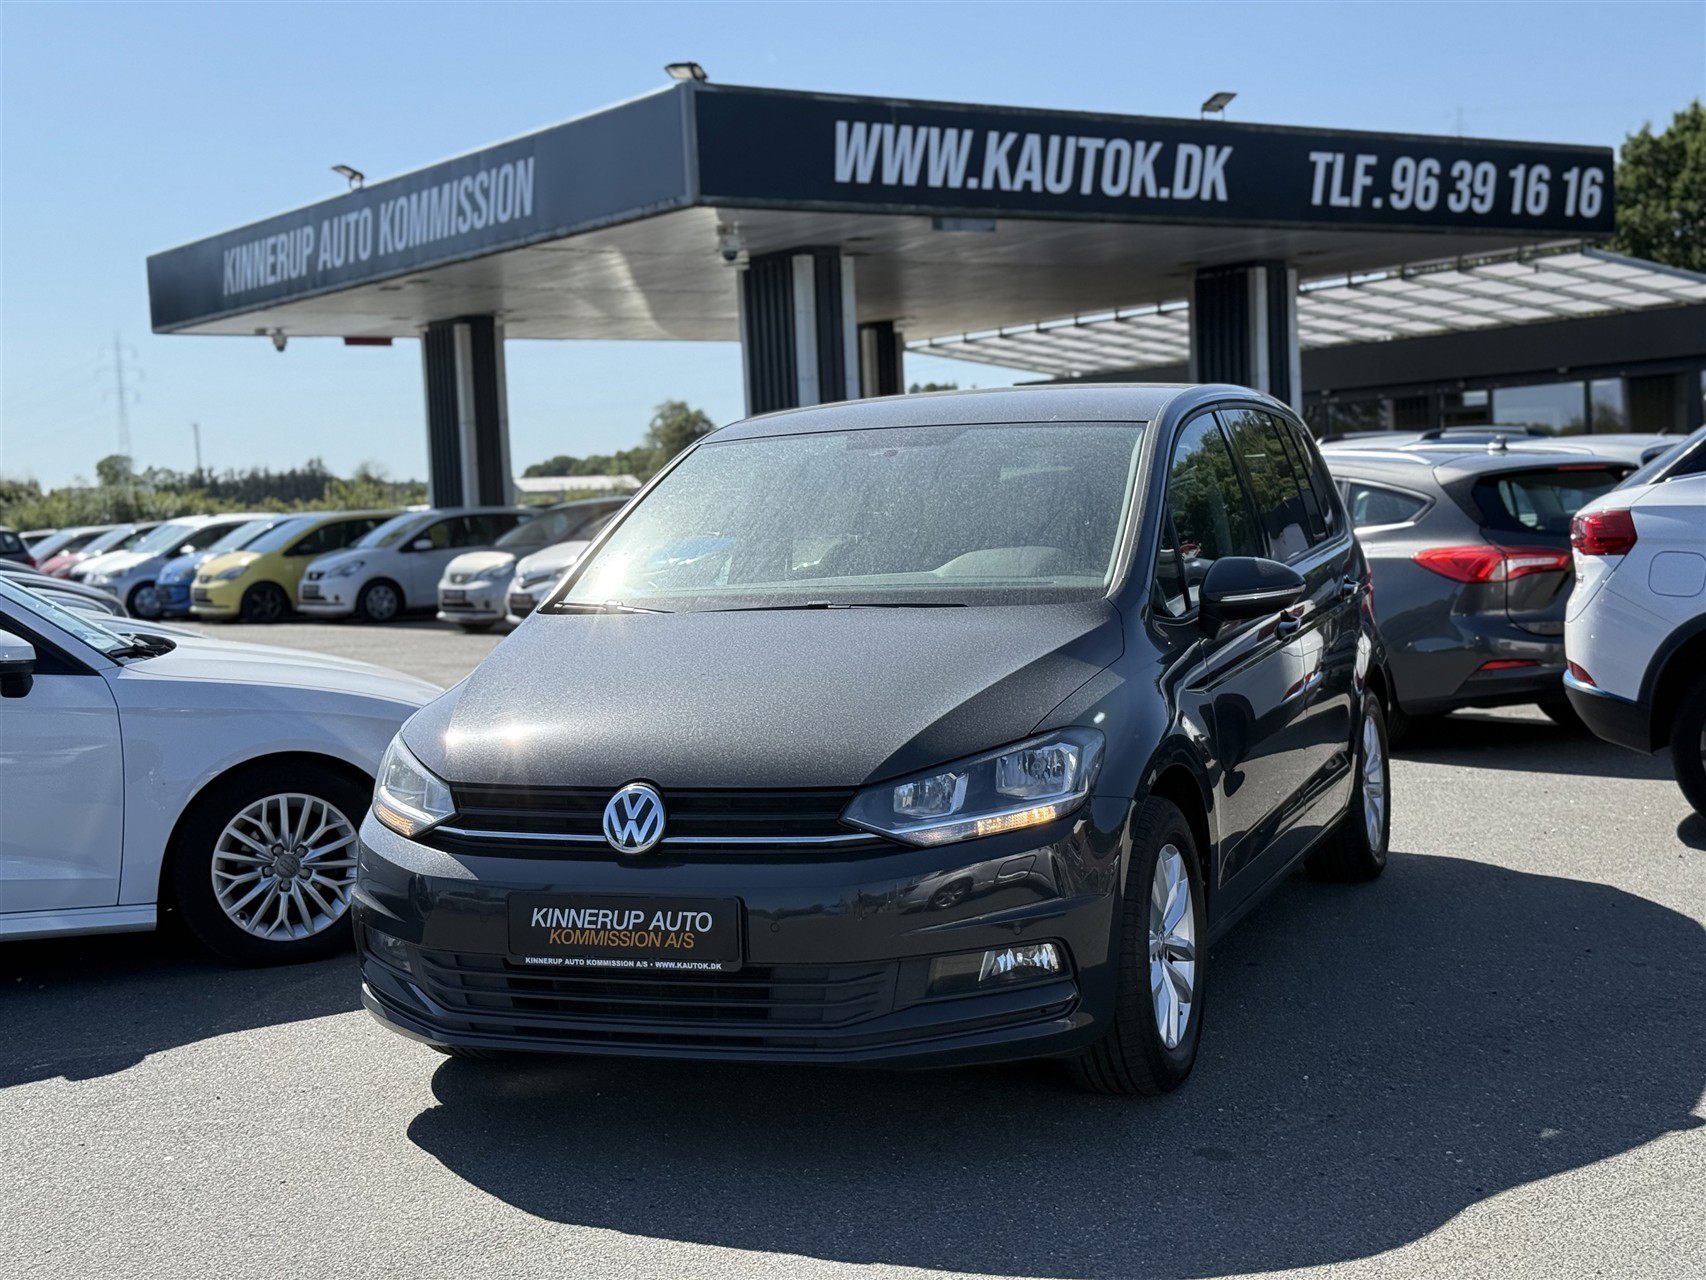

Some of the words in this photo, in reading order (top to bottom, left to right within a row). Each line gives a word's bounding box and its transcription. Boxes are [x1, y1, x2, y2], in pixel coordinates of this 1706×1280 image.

[834, 119, 1233, 202] WWW.KAUTOK.DK
[1447, 159, 1498, 215] 39
[1509, 163, 1551, 216] 16
[1563, 166, 1605, 219] 16
[222, 225, 315, 297] KINNERUP
[317, 206, 373, 271] AUTO
[378, 156, 536, 255] KOMMISSION
[530, 906, 646, 931] KINNERUP
[648, 910, 714, 933] AUTO
[549, 928, 663, 948] KOMMISSION
[664, 932, 695, 949] A/S
[525, 957, 563, 966] KINNERUP
[564, 958, 585, 967] AUTO
[586, 958, 635, 968] KOMMISSION
[636, 960, 649, 969] A/S
[654, 960, 722, 970] WWW.KAUTOK.DK
